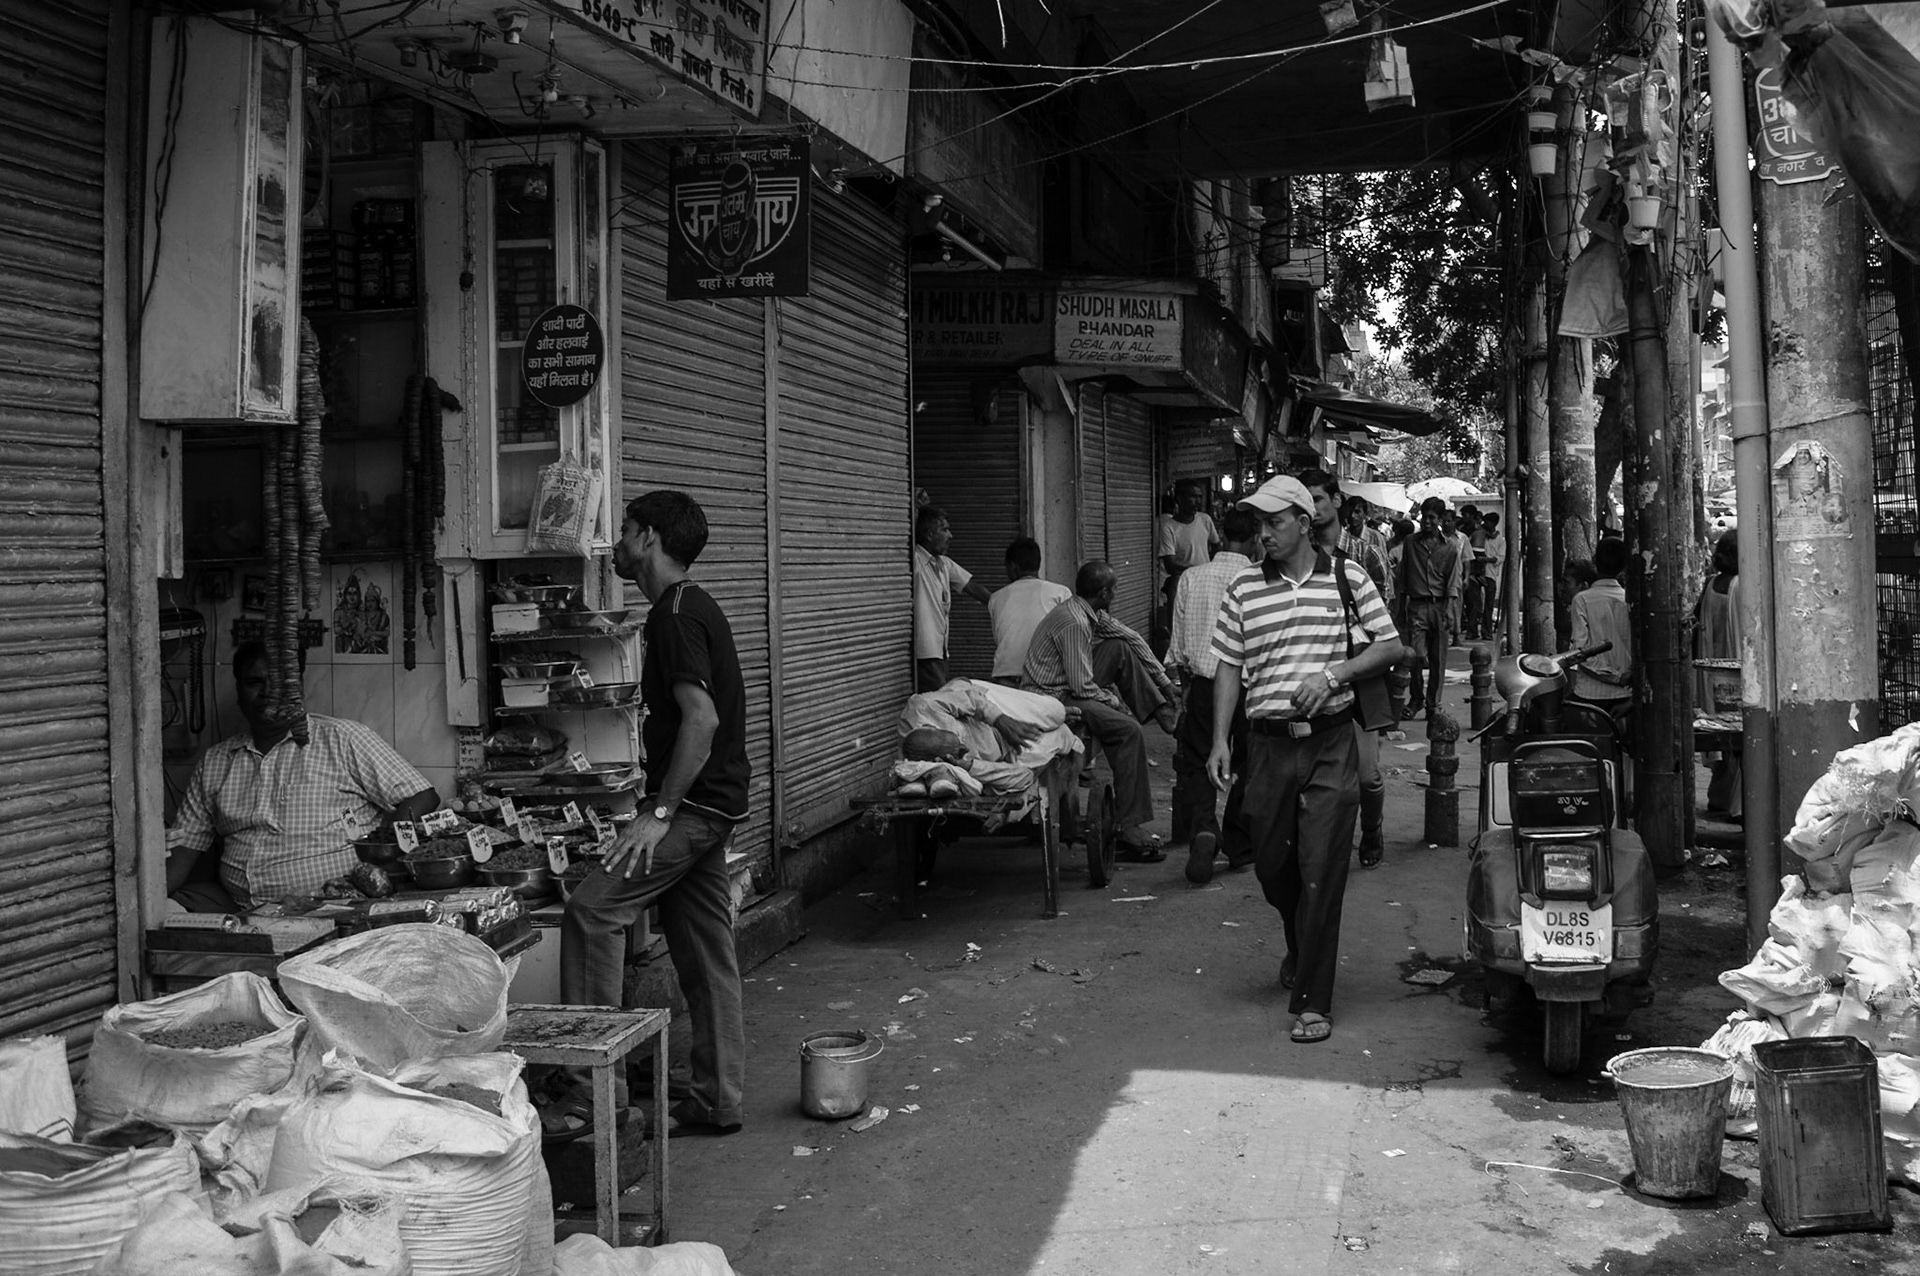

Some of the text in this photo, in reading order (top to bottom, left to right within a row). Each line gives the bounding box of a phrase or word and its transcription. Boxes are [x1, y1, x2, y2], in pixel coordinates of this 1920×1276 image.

[1777, 160, 1807, 173] नगर
[722, 220, 741, 241] चाय
[739, 271, 776, 288] खरीदें
[928, 291, 995, 324] MULKH
[1001, 291, 1045, 324] RAJ
[1059, 295, 1176, 321] SHUDH MASALA
[542, 313, 586, 332] शादी पार्टी
[1079, 320, 1154, 338] BHANDAR
[556, 331, 590, 350] हलवाई
[927, 330, 937, 344] &
[941, 330, 1004, 345] RETAILER
[1070, 338, 1155, 353] DEAL IN ALL
[527, 352, 596, 369] का सभी सामान
[1068, 349, 1173, 364] TYPE OF SNUFF
[529, 371, 548, 388] यहाँ
[549, 371, 579, 387] मिलता
[1546, 912, 1589, 927] DL8S
[1543, 930, 1595, 946] V6815
